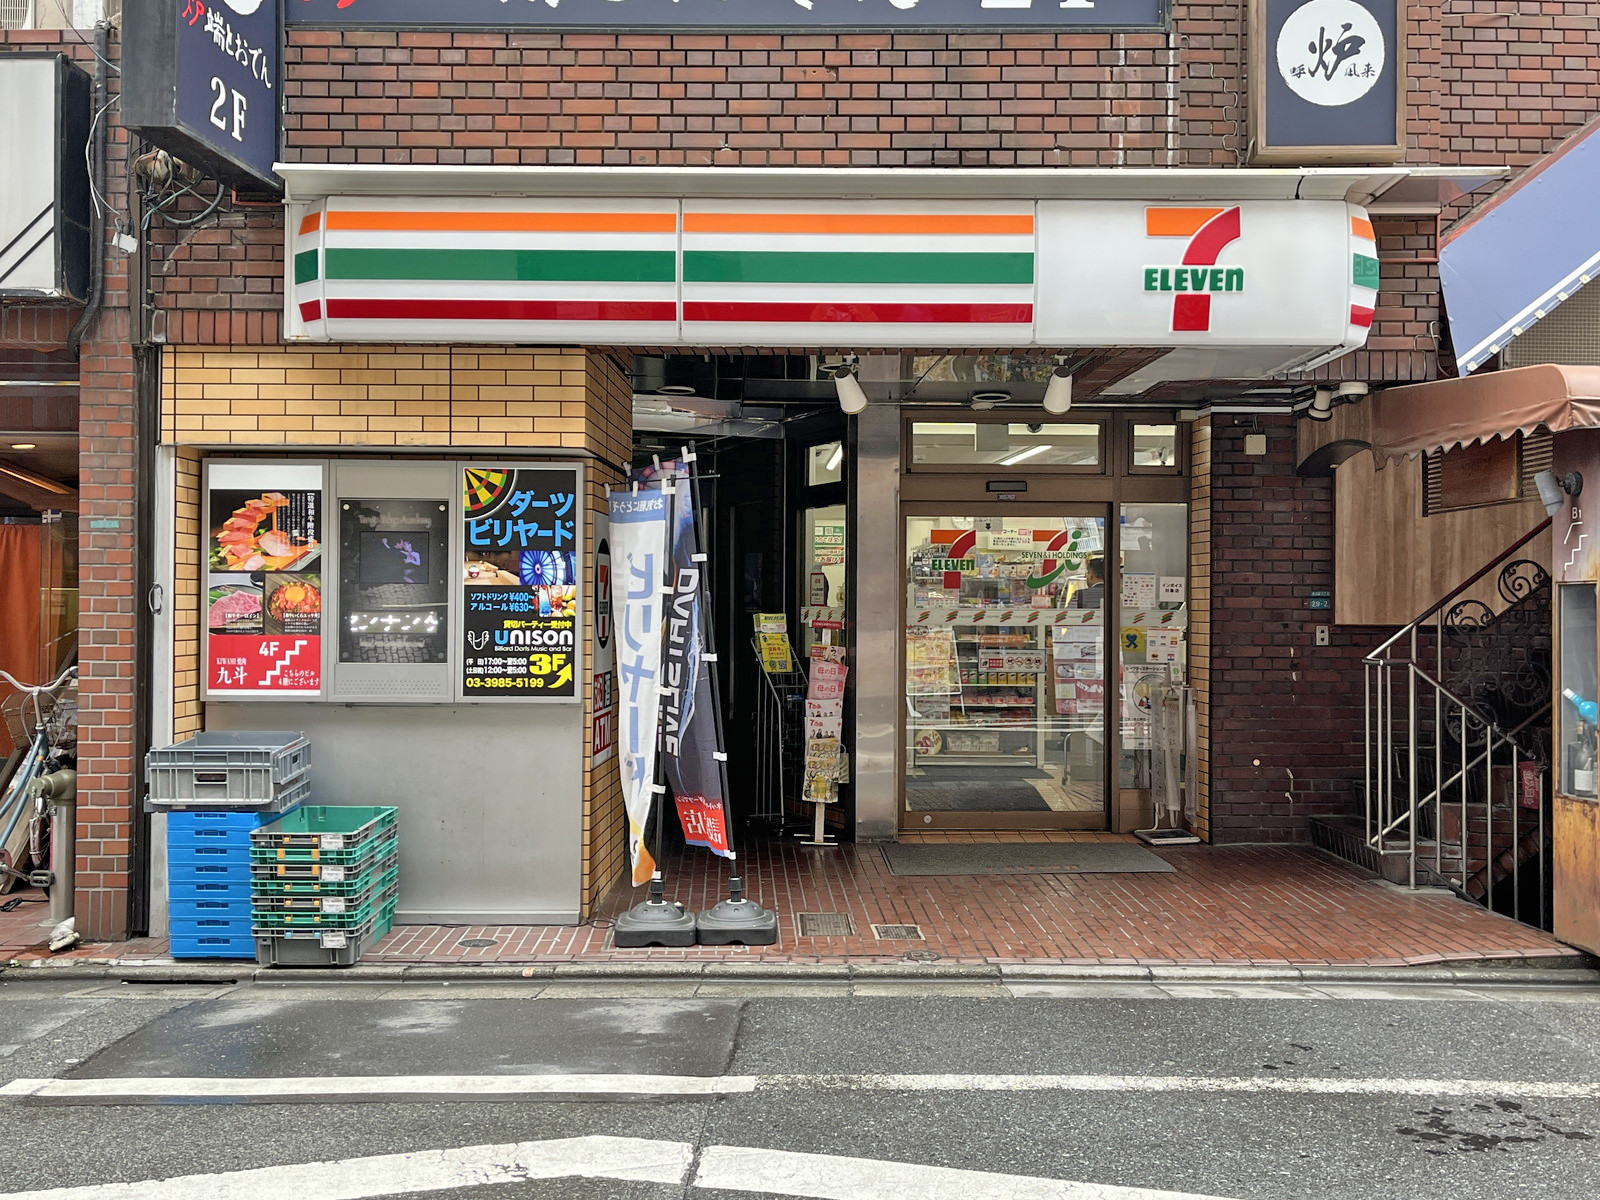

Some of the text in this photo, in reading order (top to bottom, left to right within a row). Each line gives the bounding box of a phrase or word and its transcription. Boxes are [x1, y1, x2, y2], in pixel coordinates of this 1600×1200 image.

[210, 76, 247, 142] 2F
[508, 490, 574, 517] ダーツ
[470, 518, 574, 547] ビリヤード
[1052, 551, 1088, 559] HOLDINGS
[470, 593, 509, 601] ソフトドリンク
[470, 603, 508, 611] アルコール
[259, 641, 279, 656] 4F
[529, 653, 566, 675] 3F
[216, 666, 248, 685] 九斗
[284, 669, 315, 678] こちらのビル
[466, 678, 544, 688] 03-3985-5199
[593, 714, 611, 752] ATM
